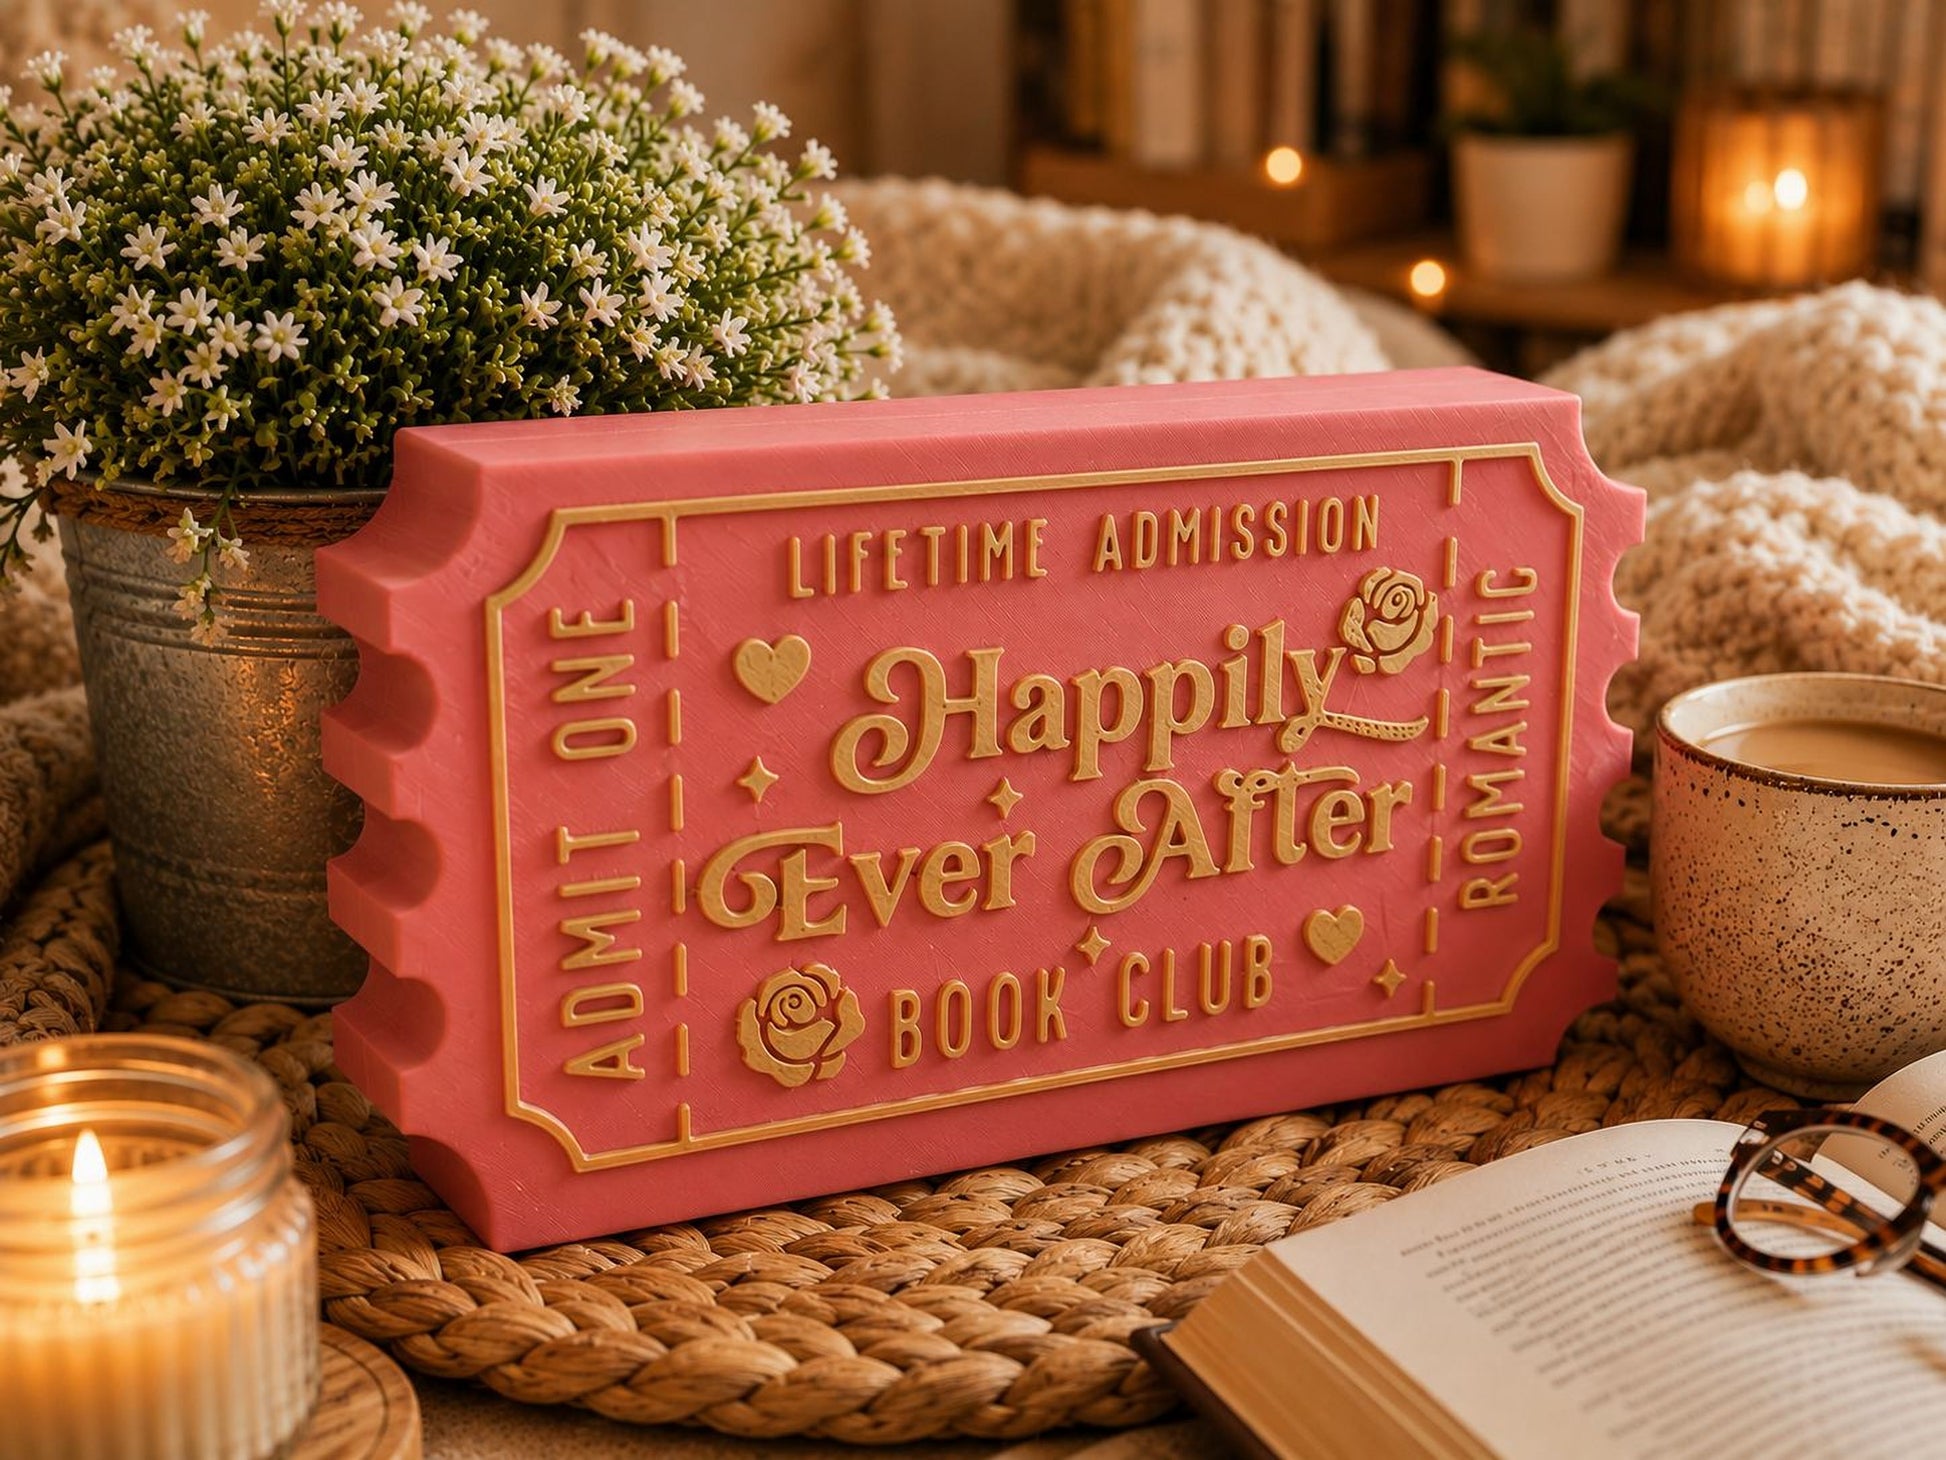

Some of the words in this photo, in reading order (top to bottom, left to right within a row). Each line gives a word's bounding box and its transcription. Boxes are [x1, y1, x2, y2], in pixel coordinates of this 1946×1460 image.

[789, 519, 1046, 598] LIFETIME
[1095, 496, 1379, 571] ADMISSION
[550, 601, 637, 760] ONE
[832, 620, 1429, 794] Happily
[1461, 568, 1537, 908] ROMANTIC
[697, 824, 1036, 942] Ever
[1071, 763, 1413, 914] After
[558, 827, 645, 1080] ADMIT
[892, 969, 1067, 1068] BOOK
[1120, 936, 1273, 1027] CLUB
